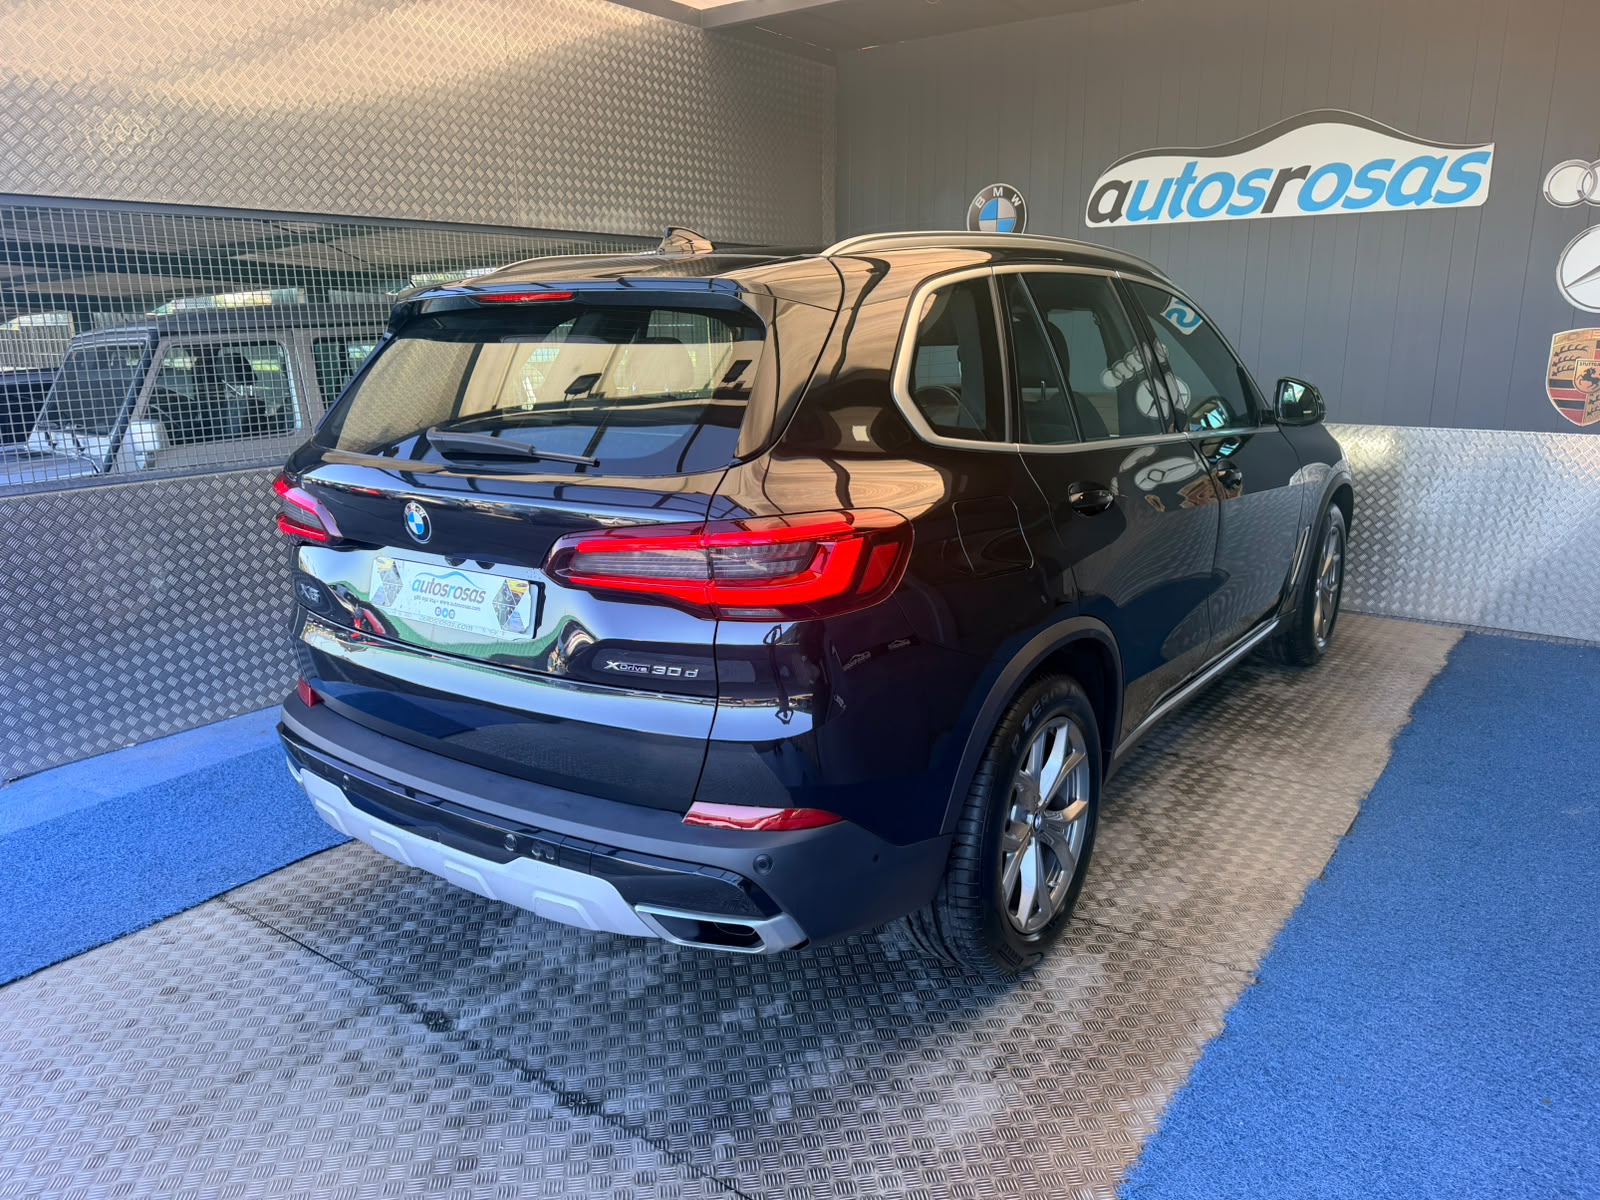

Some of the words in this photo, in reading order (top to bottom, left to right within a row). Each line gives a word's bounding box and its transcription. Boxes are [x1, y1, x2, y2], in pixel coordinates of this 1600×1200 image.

[975, 187, 1021, 209] BMW
[1087, 151, 1492, 224] autosrosas
[411, 578, 487, 604] autosrosas
